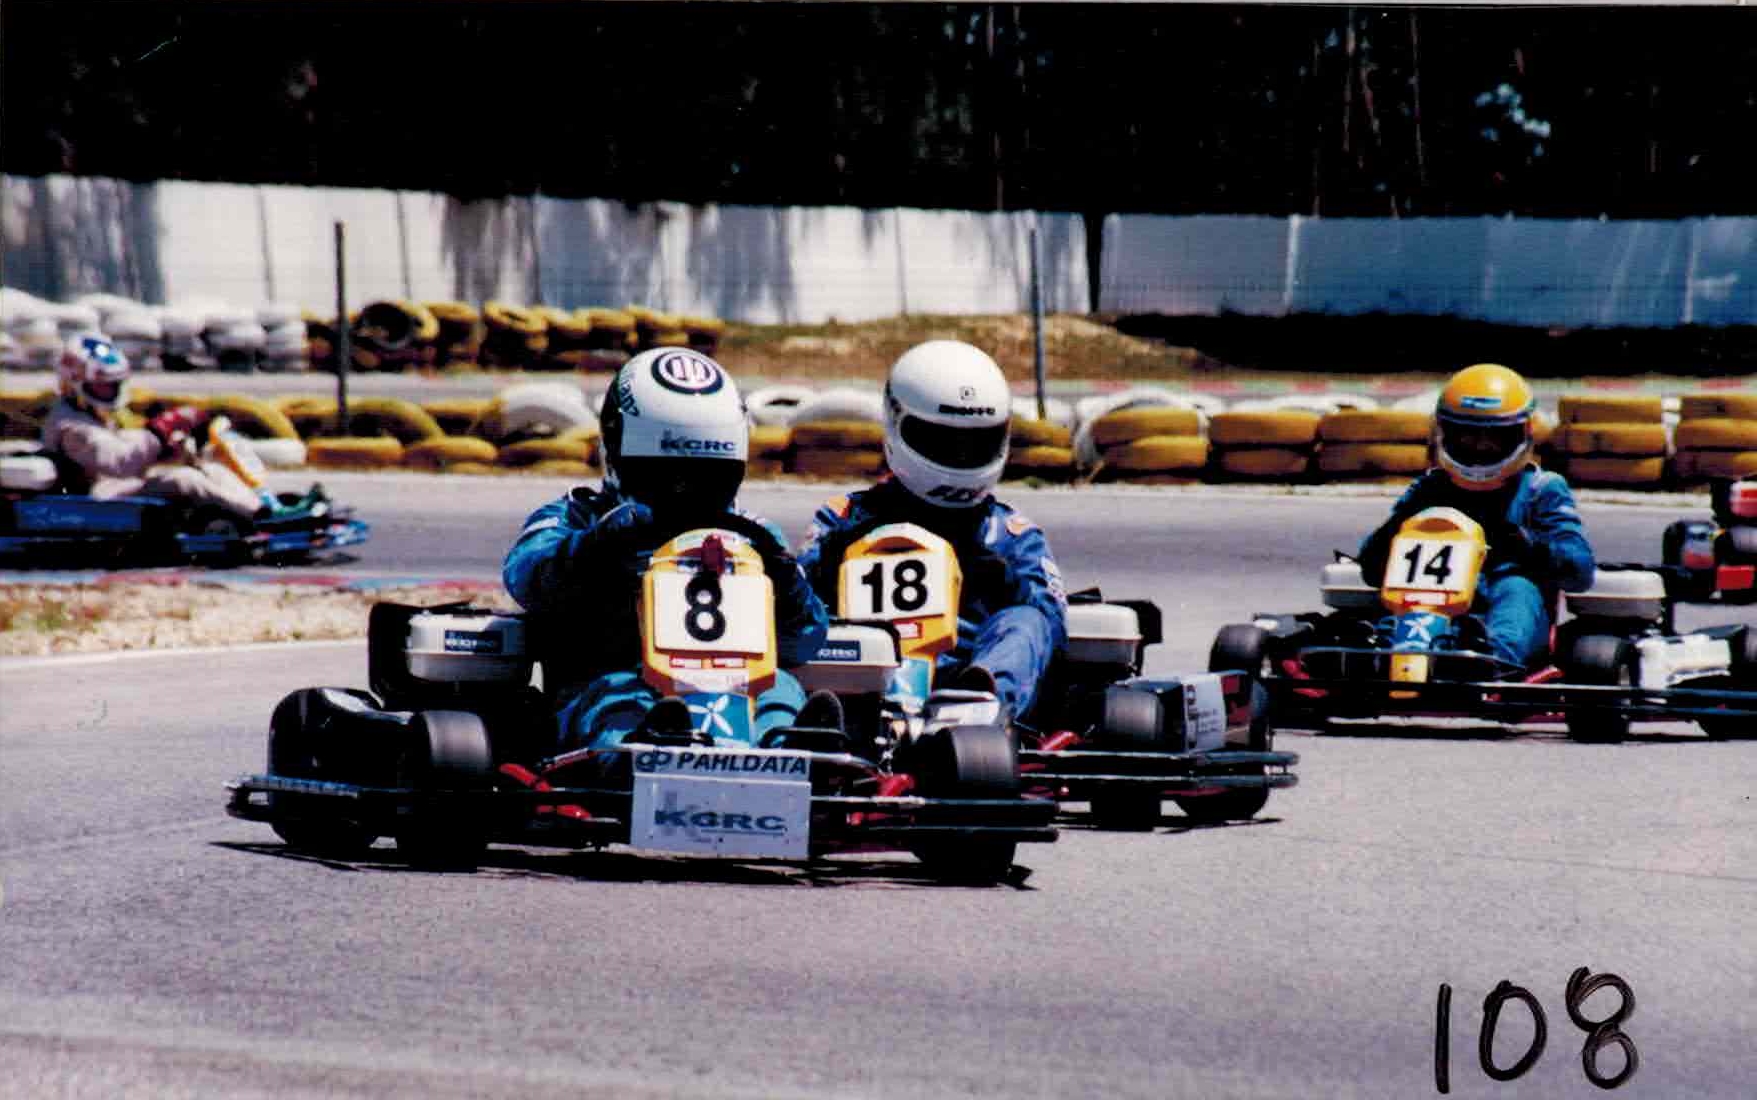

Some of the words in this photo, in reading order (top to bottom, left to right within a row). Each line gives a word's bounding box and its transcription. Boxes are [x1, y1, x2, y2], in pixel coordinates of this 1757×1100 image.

[860, 559, 928, 614] 18
[1404, 543, 1454, 585] 14
[684, 569, 727, 642] 8
[676, 752, 807, 775] PAHLDATA
